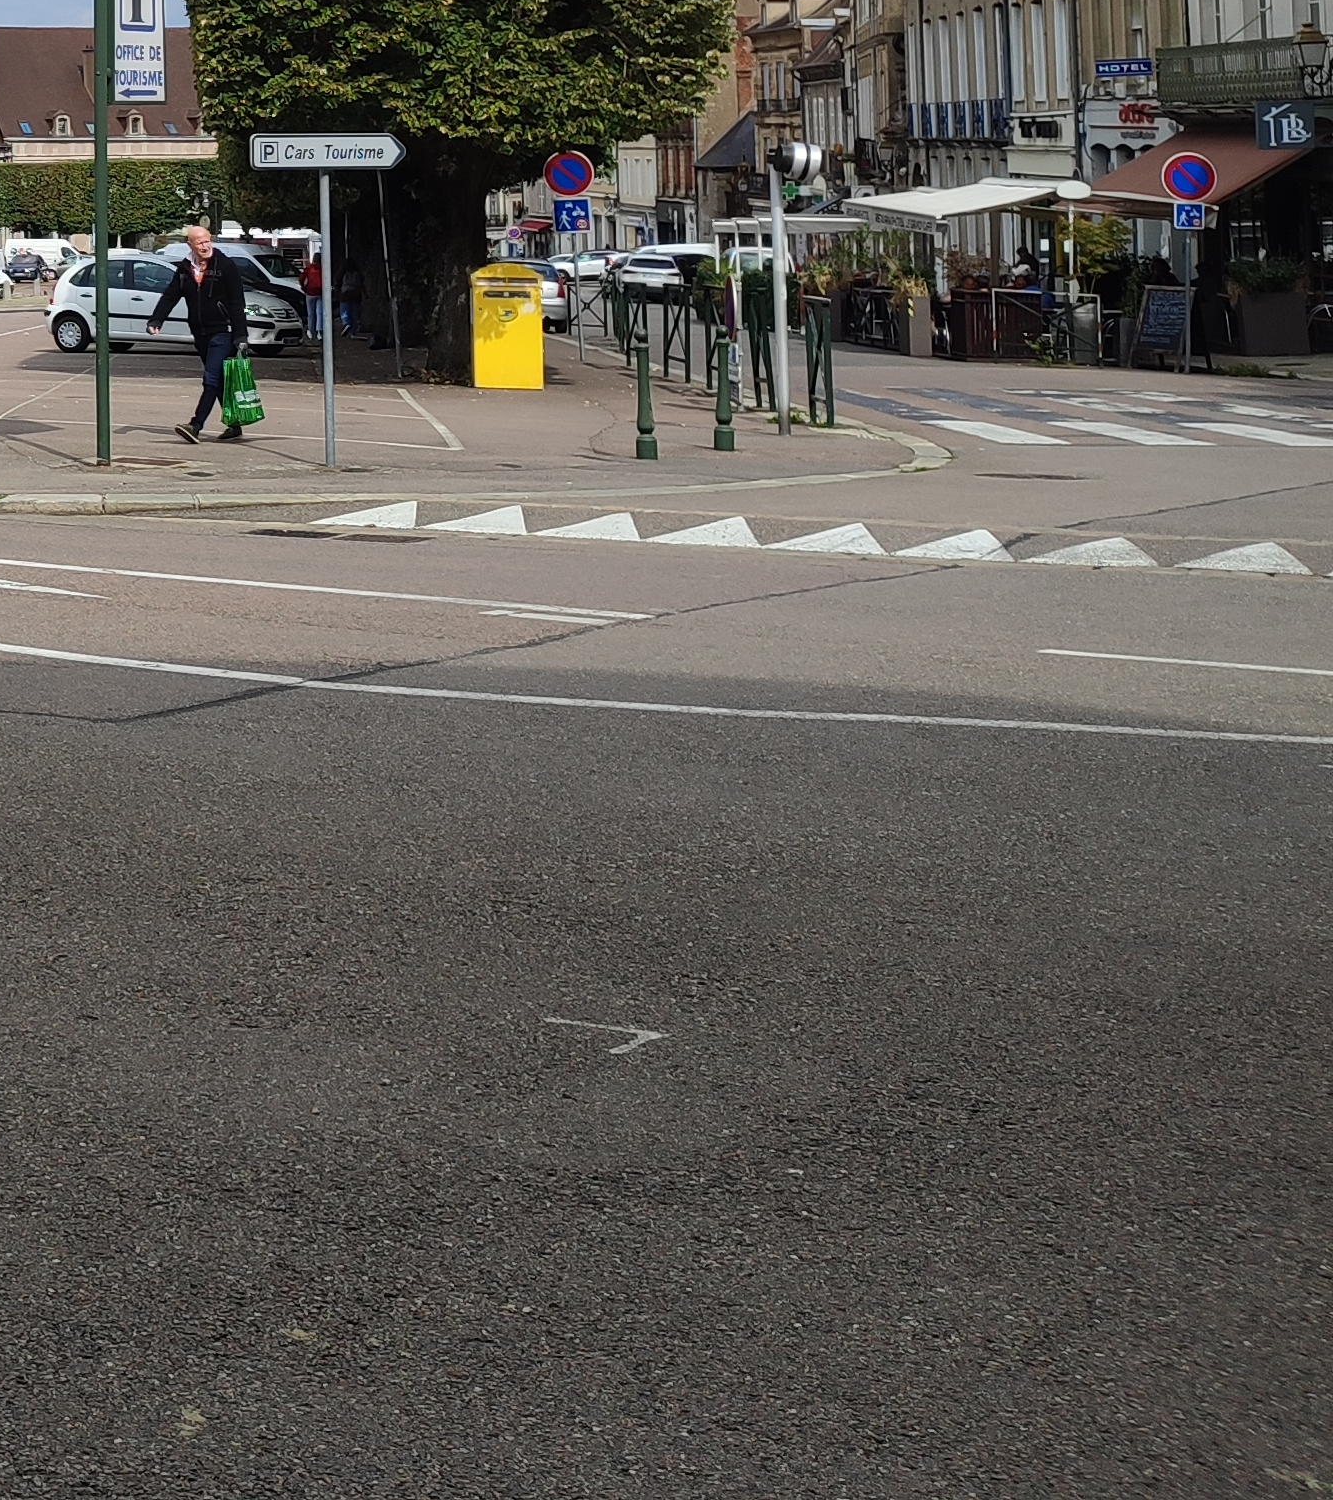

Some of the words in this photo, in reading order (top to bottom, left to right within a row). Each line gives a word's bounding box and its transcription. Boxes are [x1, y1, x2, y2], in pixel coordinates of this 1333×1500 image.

[115, 44, 145, 61] OFFICE
[149, 45, 162, 62] DE
[115, 70, 163, 86] TOURISME
[284, 144, 315, 160] Cars
[324, 143, 384, 160] Tourisme
